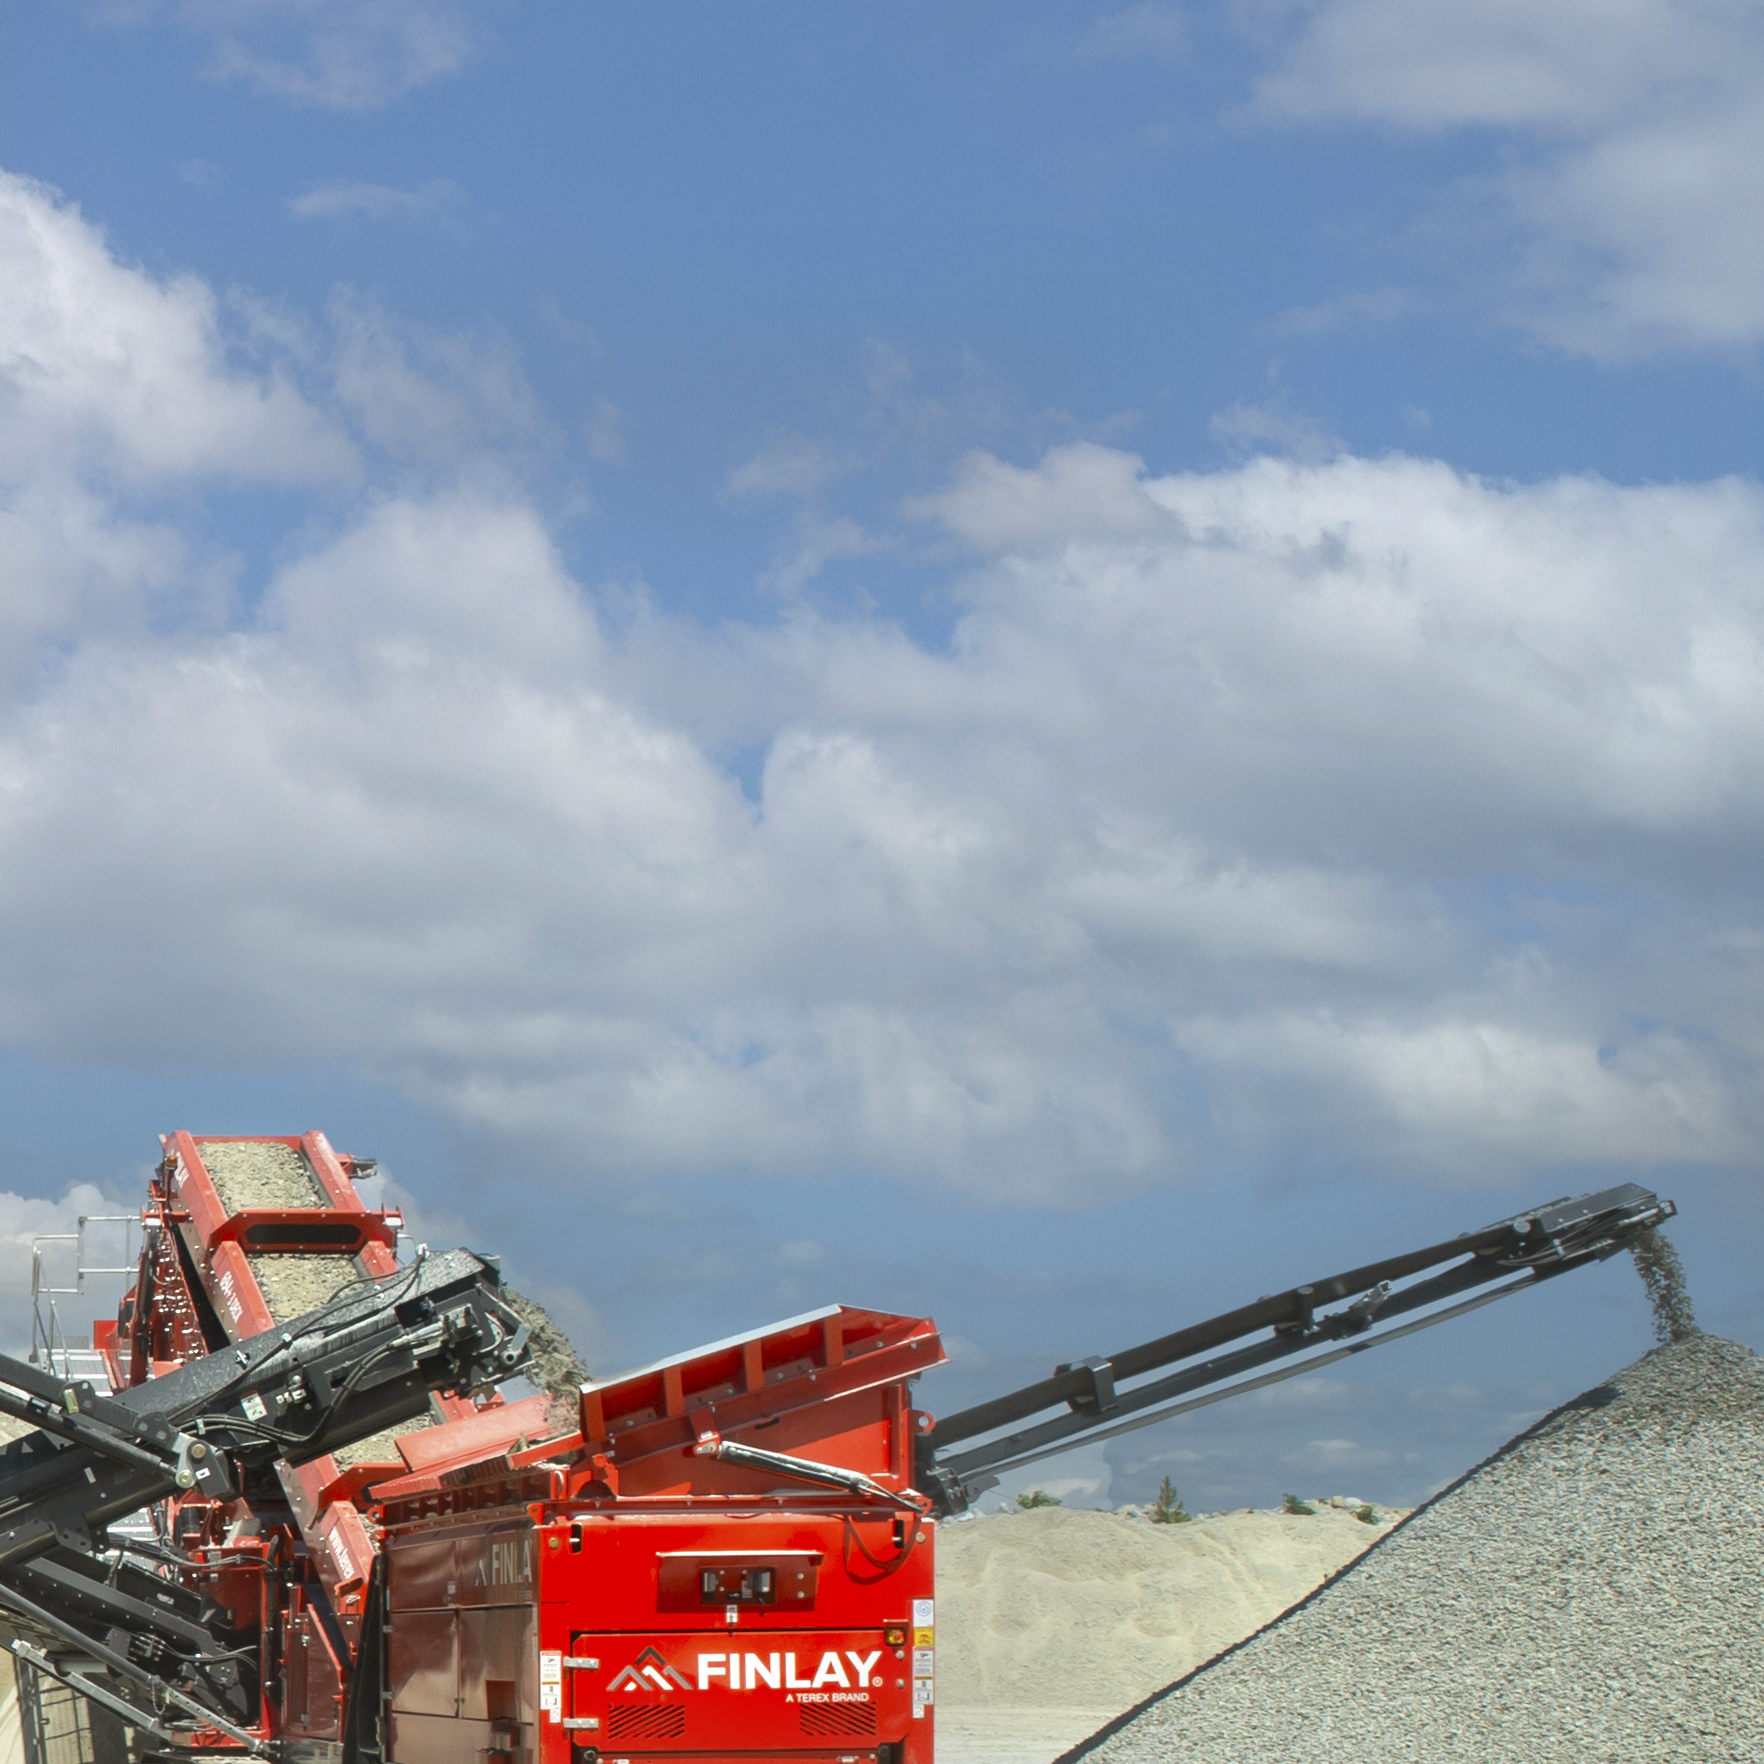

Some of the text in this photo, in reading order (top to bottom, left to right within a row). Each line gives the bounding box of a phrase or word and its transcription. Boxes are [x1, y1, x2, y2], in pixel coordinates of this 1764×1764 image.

[697, 1650, 883, 1691] FINLAY
[785, 1691, 869, 1704] A TEREX BRAND
